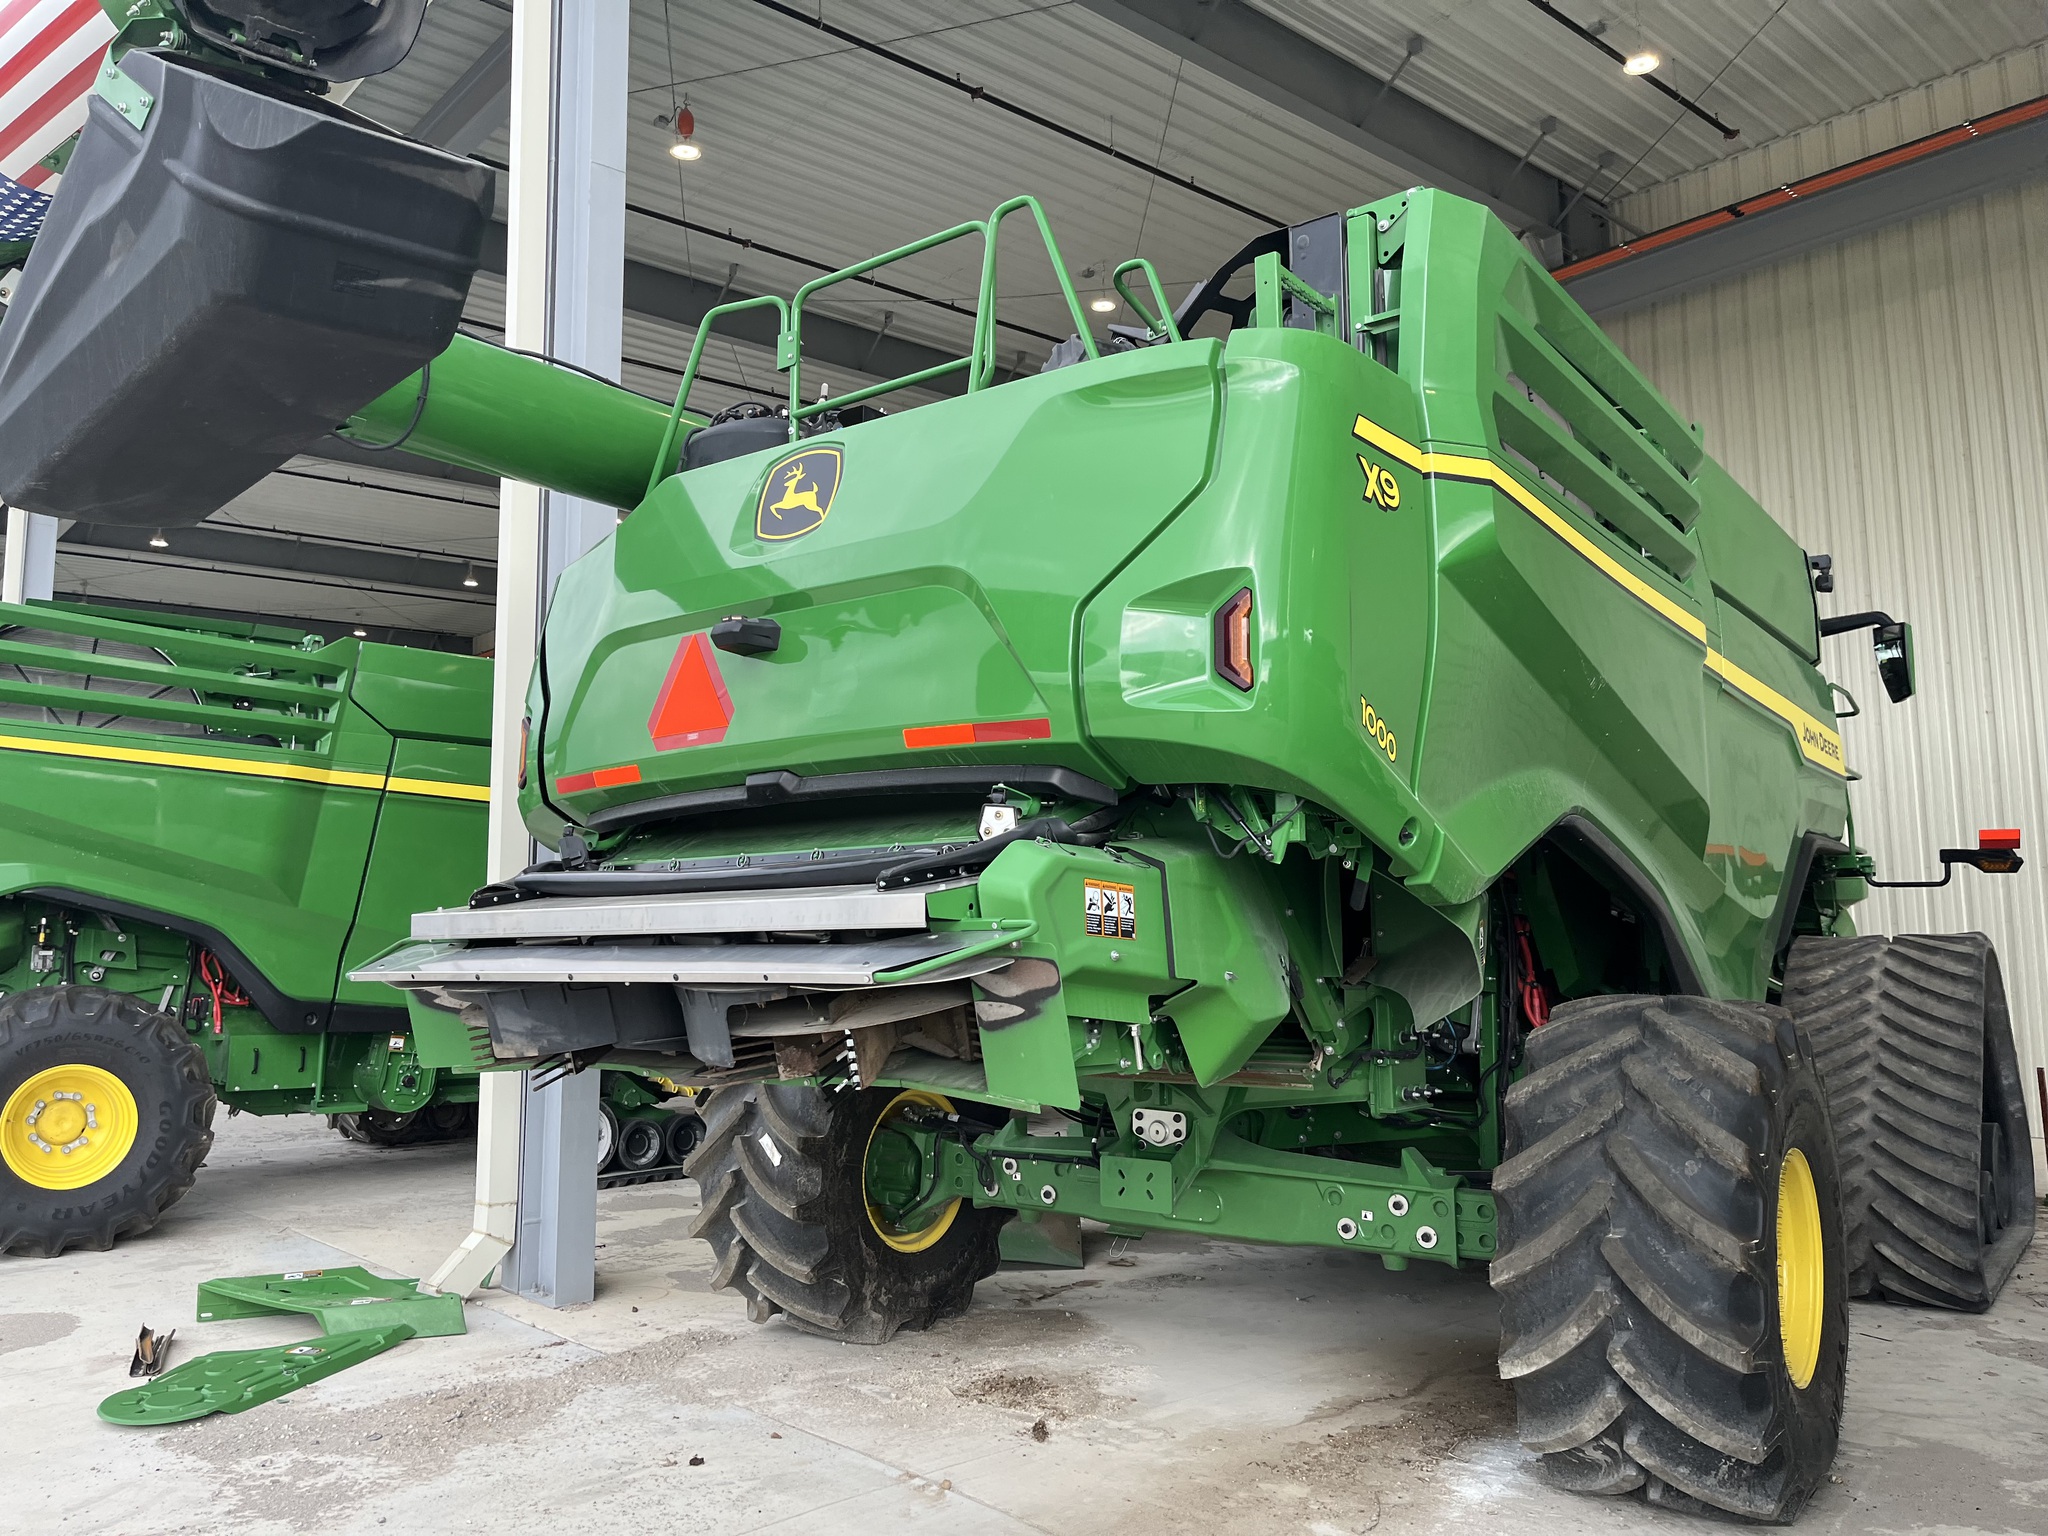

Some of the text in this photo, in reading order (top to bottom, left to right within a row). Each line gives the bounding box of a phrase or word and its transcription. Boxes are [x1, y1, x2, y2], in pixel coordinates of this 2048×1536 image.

[1356, 453, 1401, 512] X9
[1360, 694, 1397, 763] 1000
[1803, 722, 1840, 761] JOHN DEERE
[52, 1101, 172, 1219] GOODYEAR
